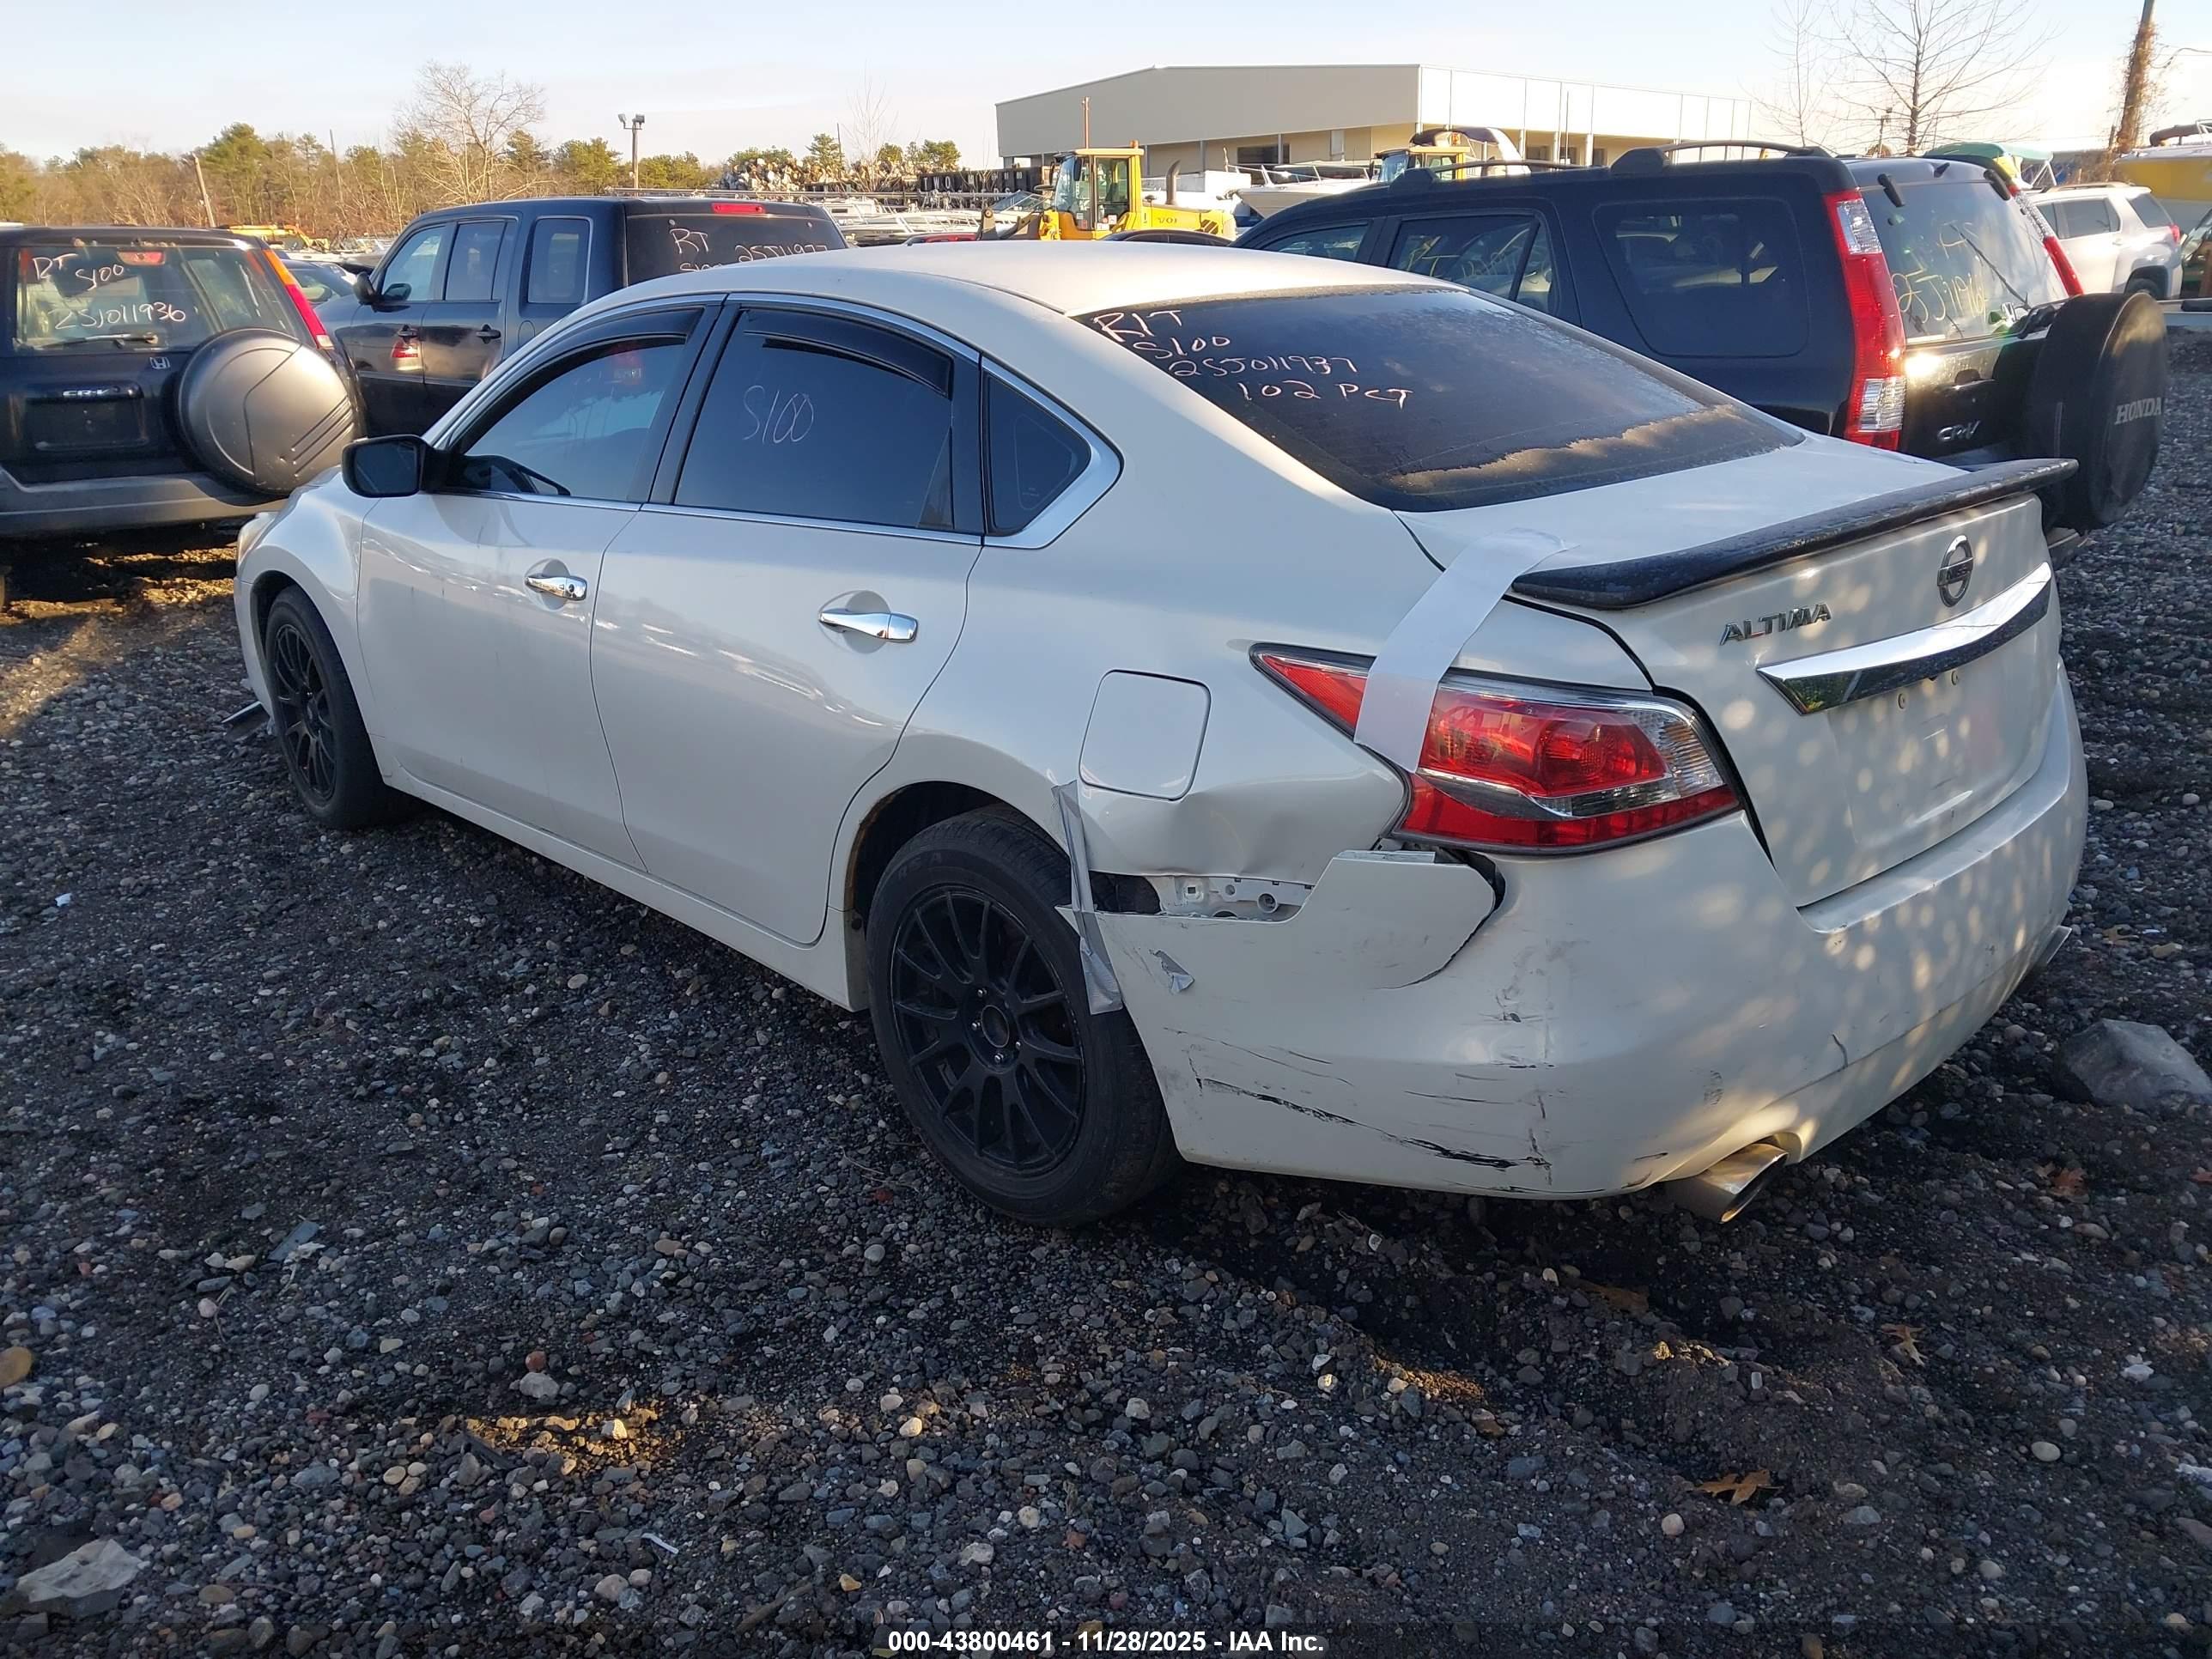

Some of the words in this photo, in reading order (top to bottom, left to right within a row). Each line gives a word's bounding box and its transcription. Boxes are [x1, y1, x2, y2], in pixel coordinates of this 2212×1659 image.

[670, 228, 708, 253] RT
[76, 264, 125, 291] S100
[1133, 336, 1231, 359] S100
[1237, 380, 1322, 401] 102
[1334, 383, 1413, 410] PCT
[2114, 397, 2162, 425] HONDA
[1719, 602, 1832, 646] ALTIMA
